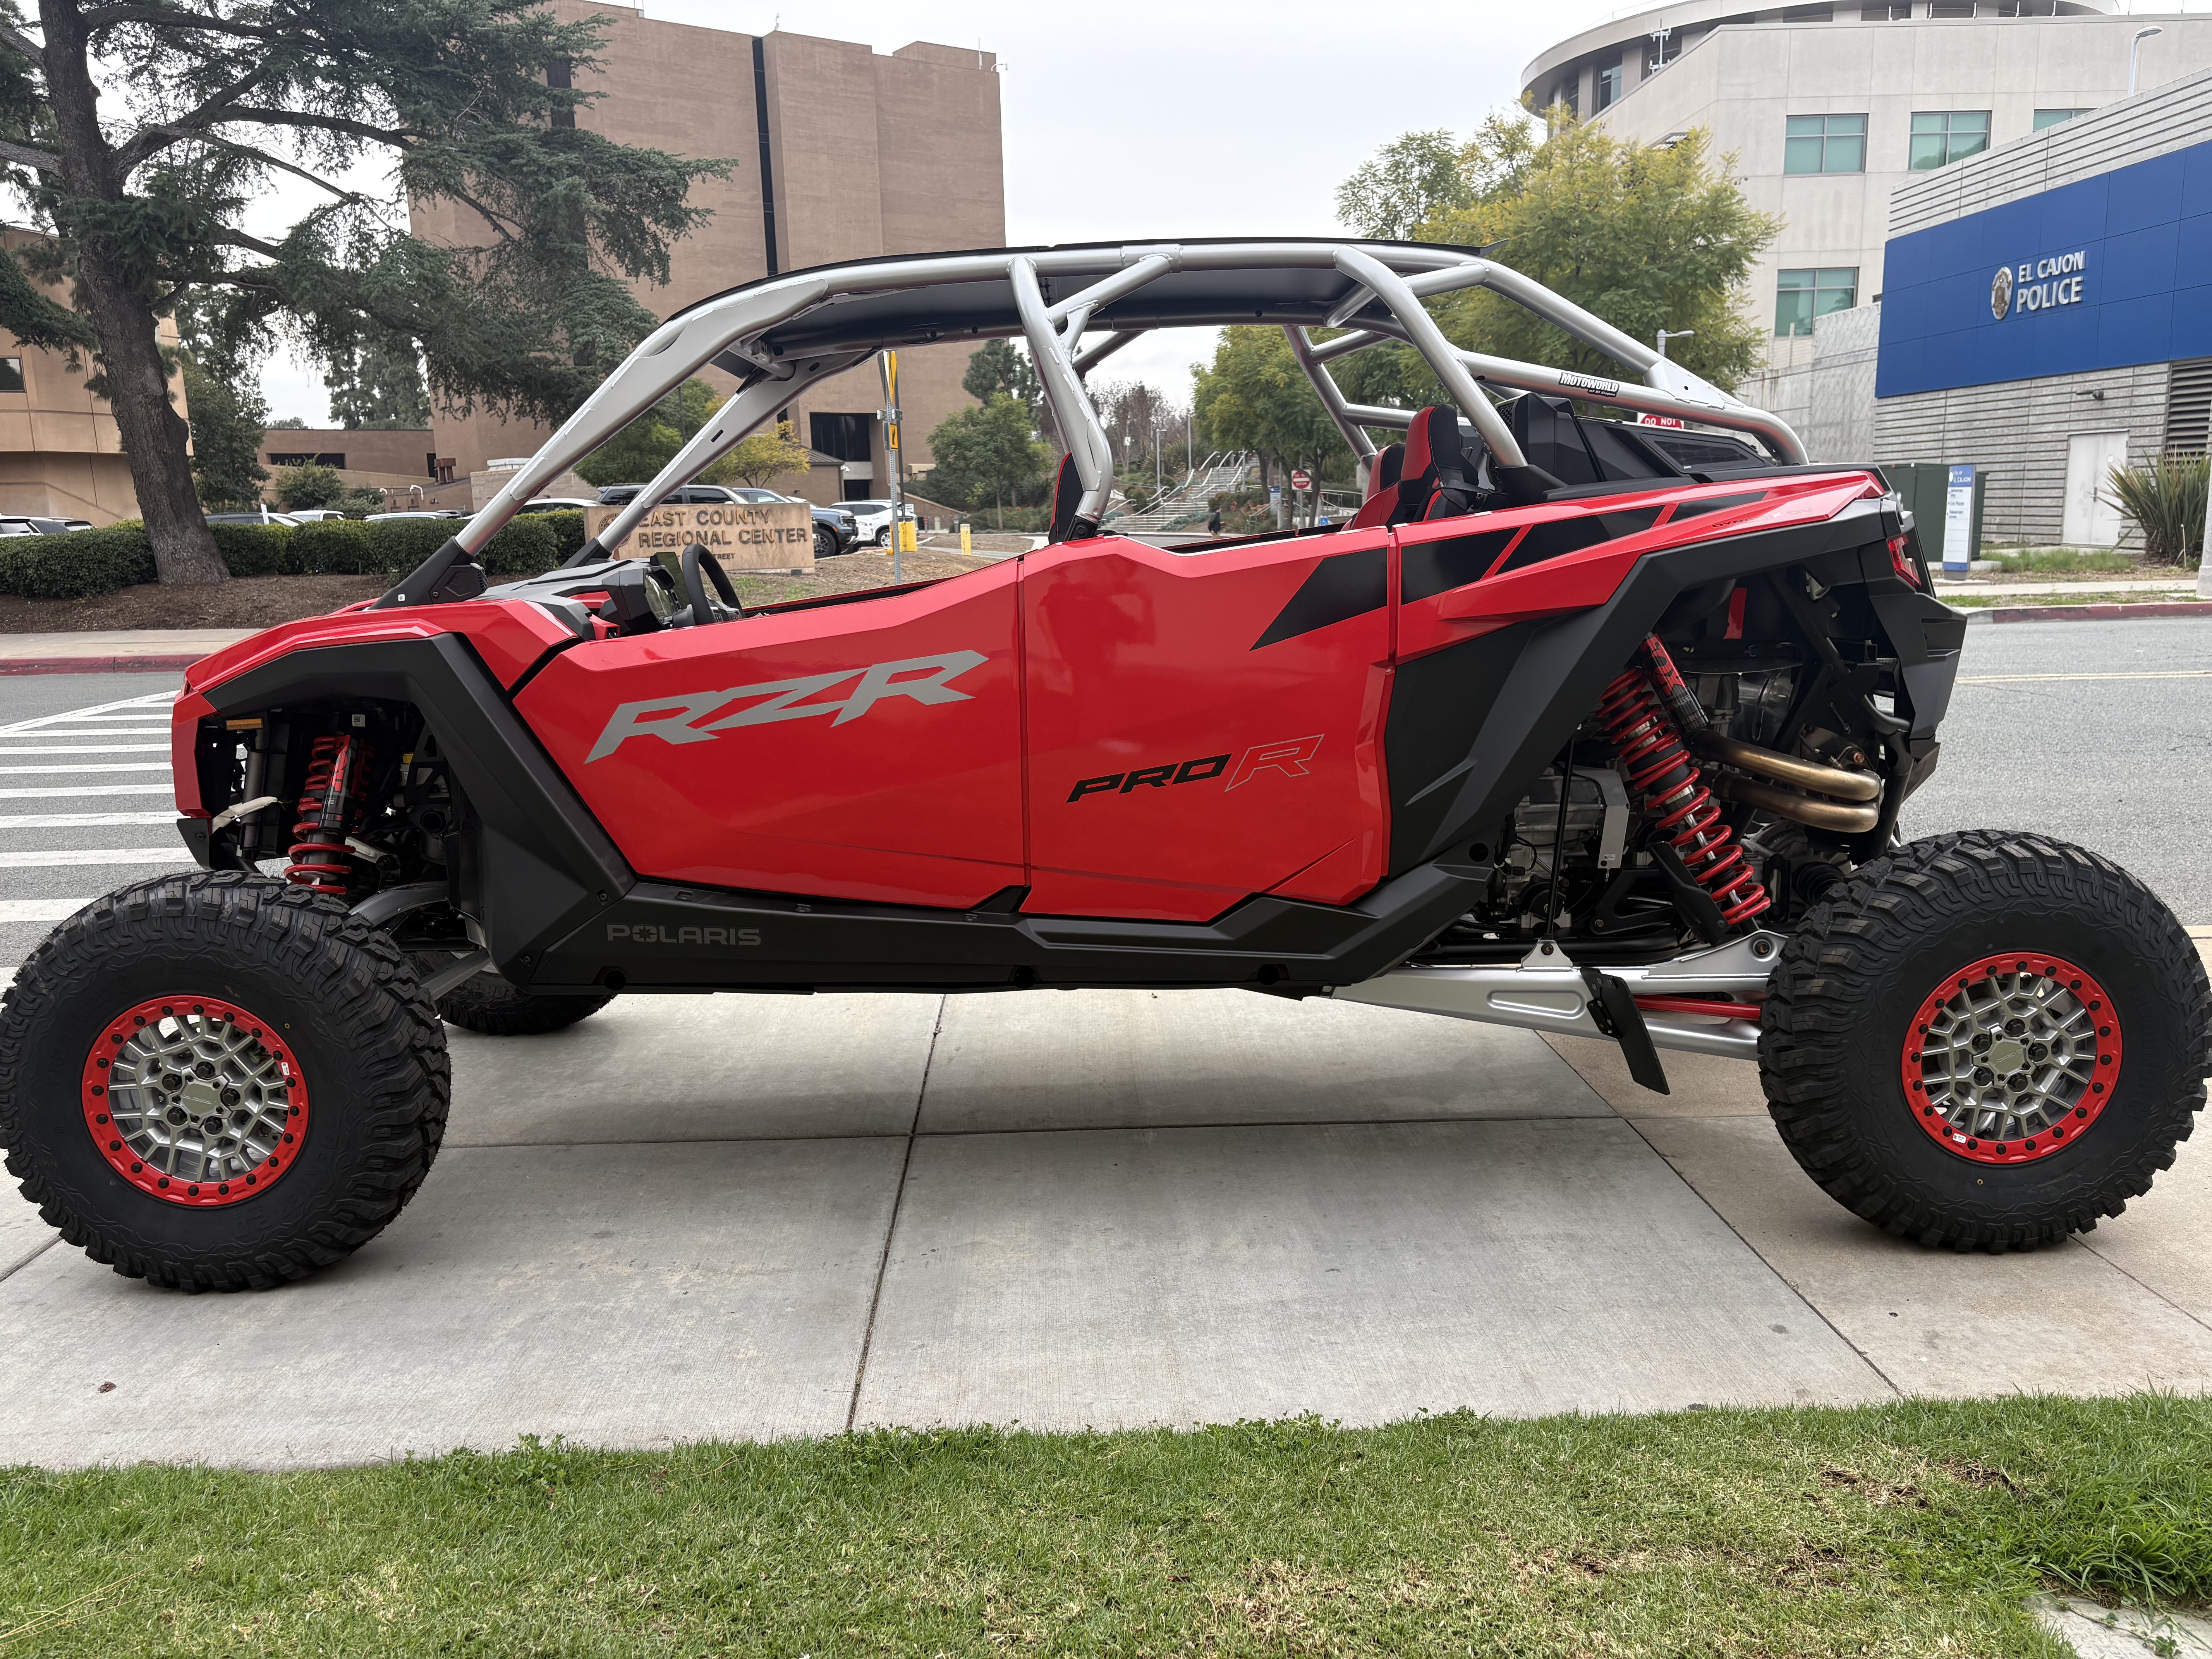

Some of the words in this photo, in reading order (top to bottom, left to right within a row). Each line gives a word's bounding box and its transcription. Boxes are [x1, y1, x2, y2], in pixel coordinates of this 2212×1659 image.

[2018, 264, 2034, 283] EL
[2037, 251, 2086, 279] CAJON
[2016, 276, 2083, 313] POLICE
[1560, 373, 1619, 392] MOTOWORLD
[697, 508, 771, 526] COUNTY
[639, 530, 732, 548] REGIONAL
[738, 528, 808, 544] CENTER
[584, 649, 989, 764] RZR
[1066, 752, 1233, 804] PRO
[1224, 734, 1325, 793] R
[606, 923, 762, 946] POLARIS
